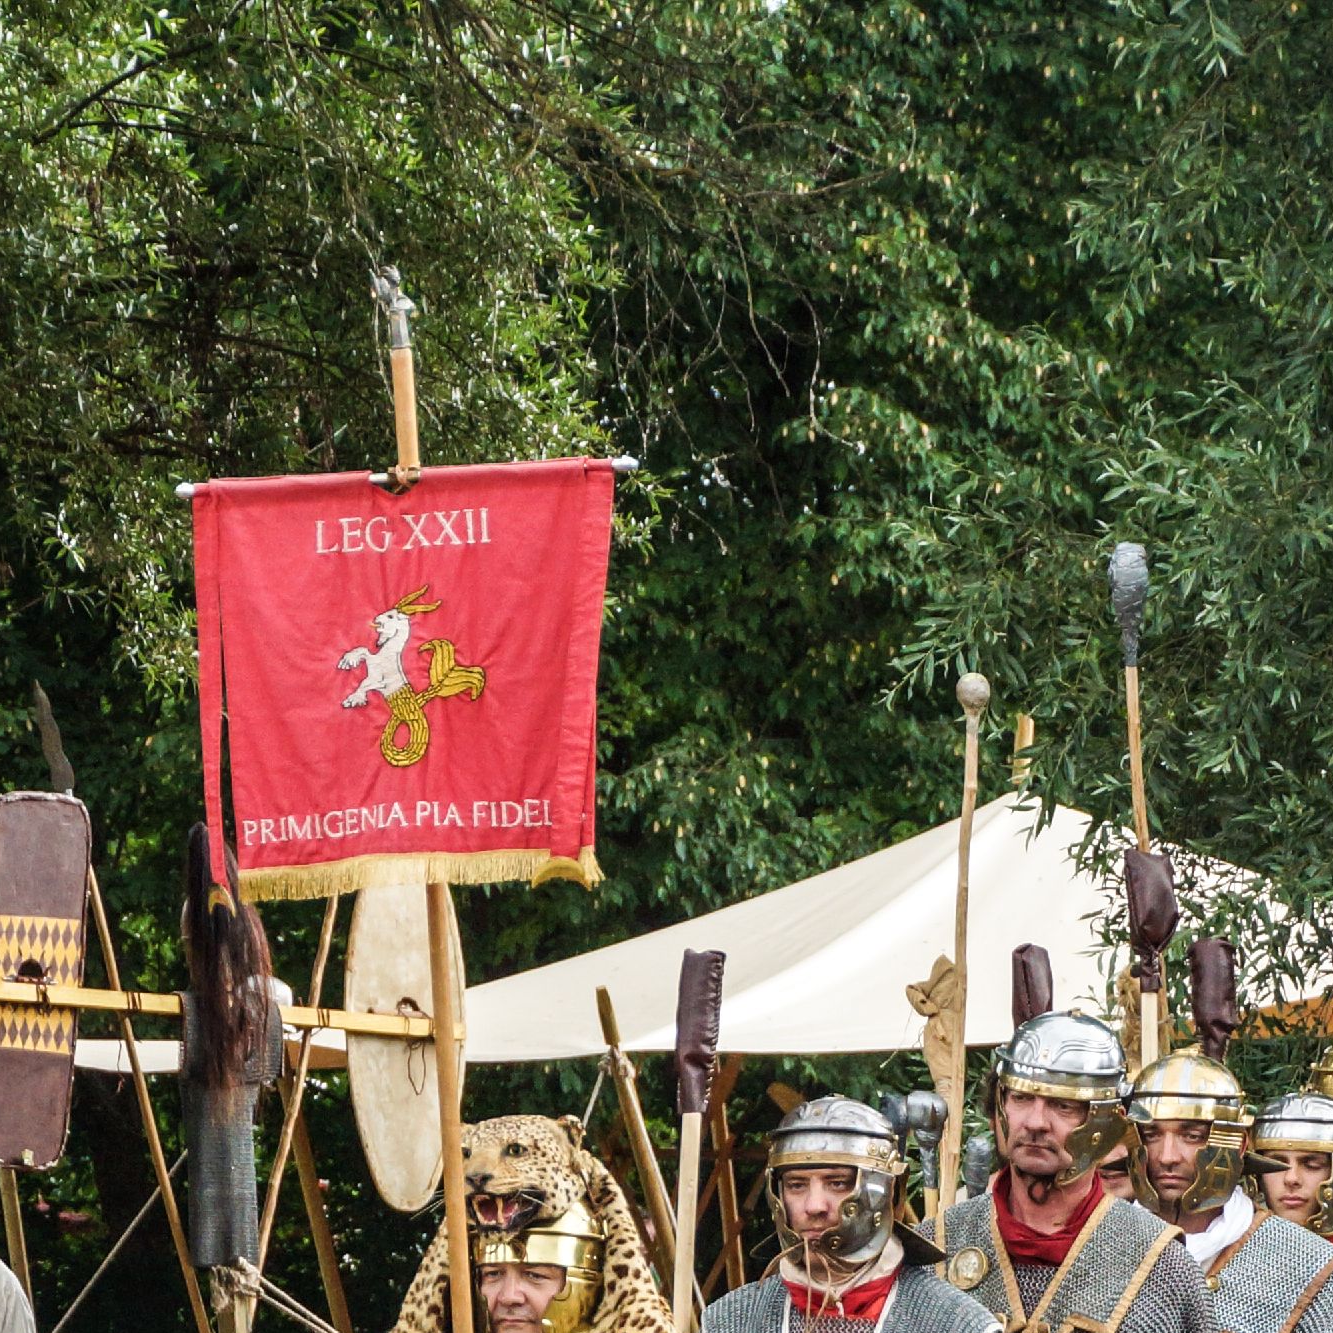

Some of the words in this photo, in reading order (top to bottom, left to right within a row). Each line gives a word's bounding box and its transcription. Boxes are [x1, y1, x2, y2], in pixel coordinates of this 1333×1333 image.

[315, 516, 393, 554] LEG
[401, 507, 492, 550] XXII
[242, 801, 409, 846] PRIMIGENIA
[415, 800, 465, 828] PIA
[472, 798, 553, 828] FIDEL
